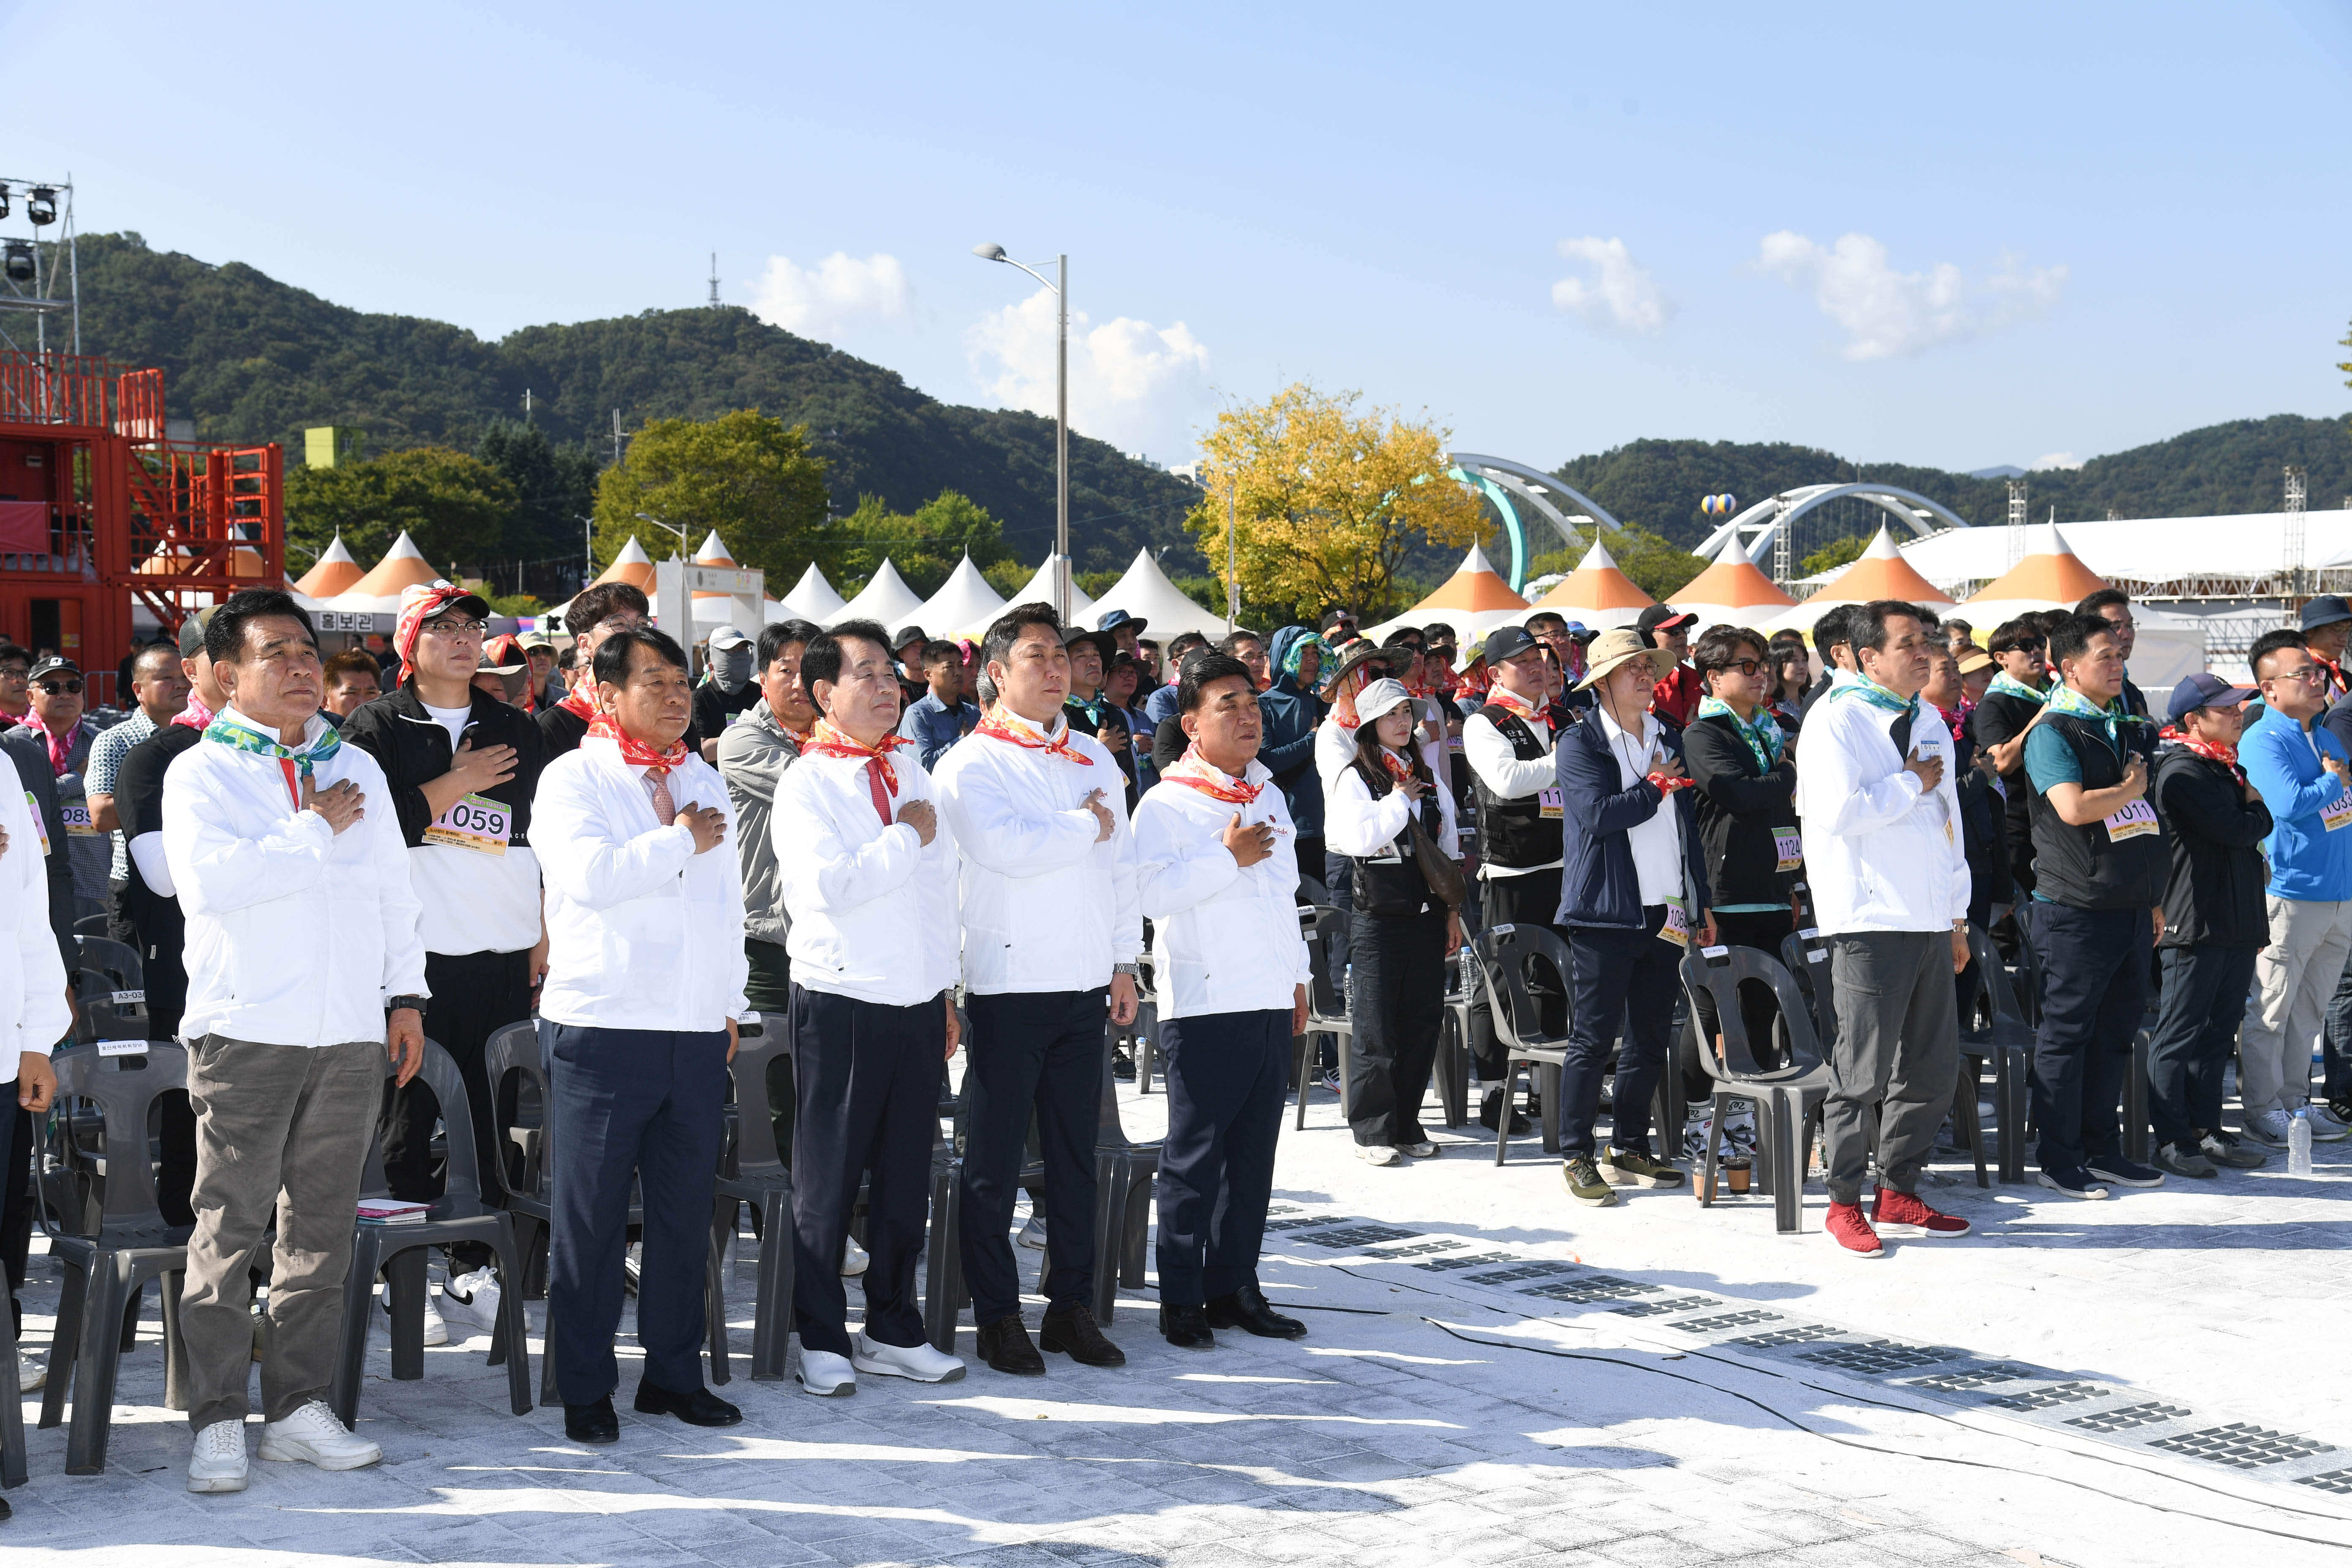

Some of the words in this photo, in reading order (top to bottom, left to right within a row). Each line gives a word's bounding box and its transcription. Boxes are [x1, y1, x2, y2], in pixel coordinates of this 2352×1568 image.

[322, 614, 371, 629] 홍보관
[1449, 735, 1463, 744] 106
[1780, 839, 1800, 856] 1124
[1671, 908, 1688, 930] 1064
